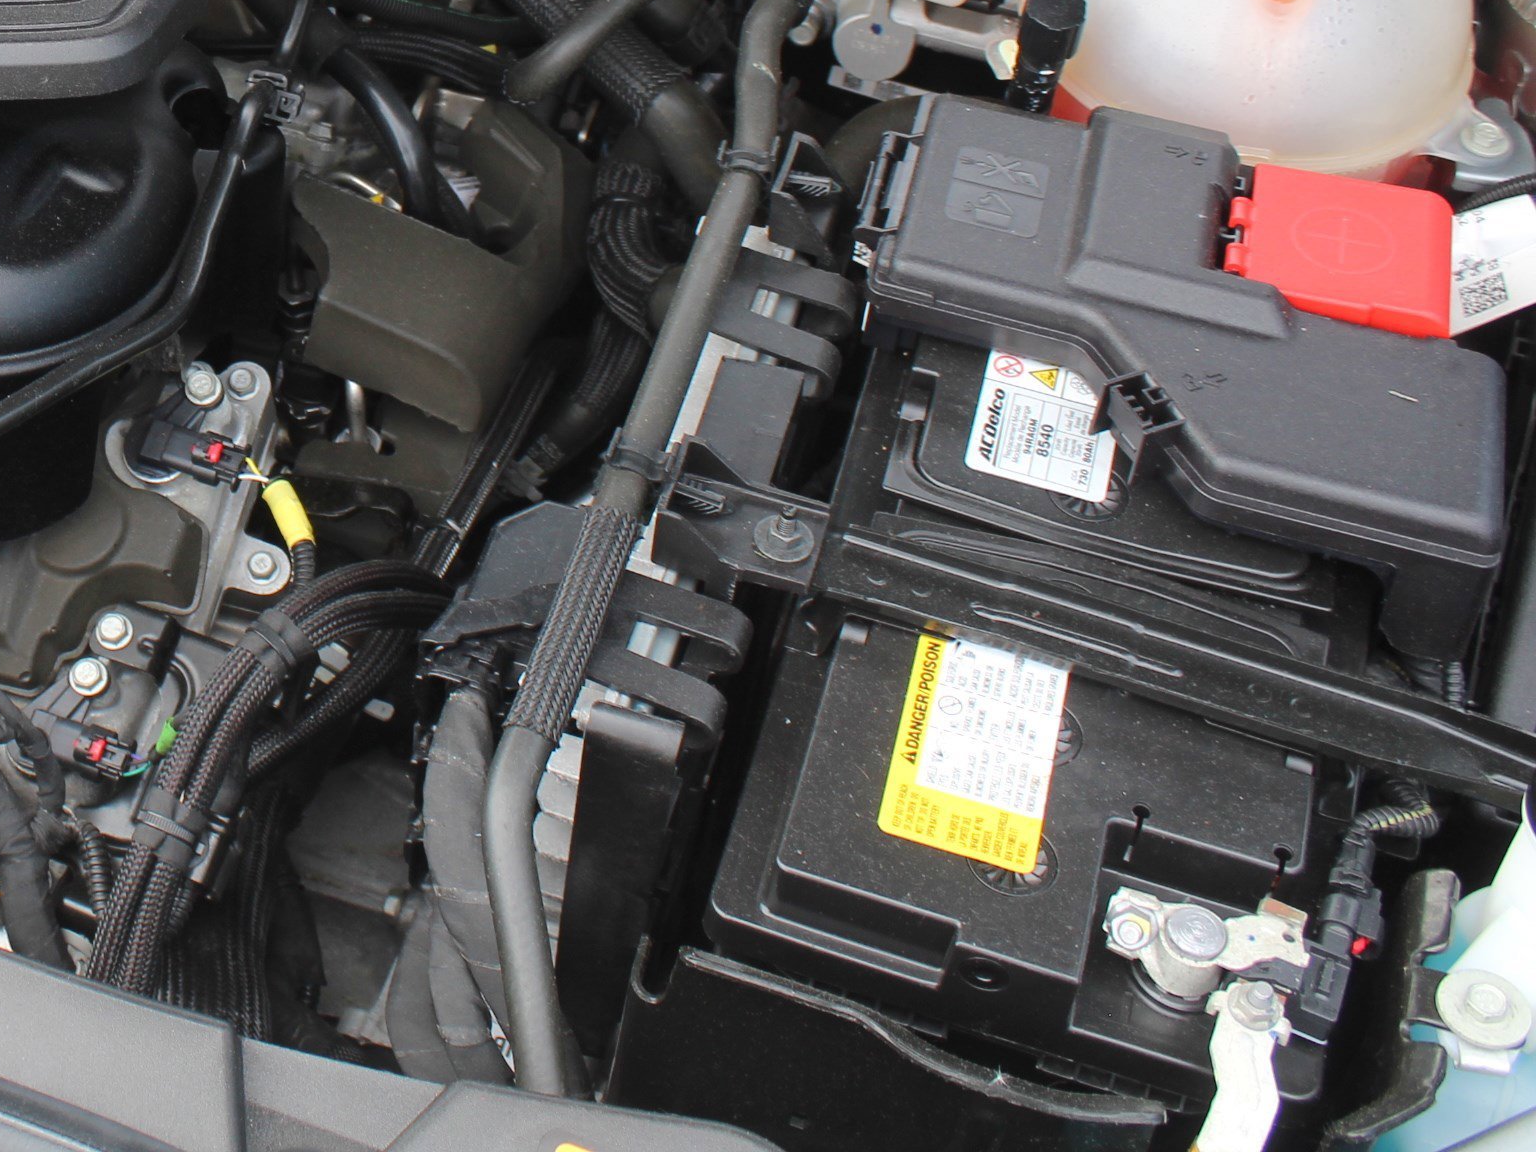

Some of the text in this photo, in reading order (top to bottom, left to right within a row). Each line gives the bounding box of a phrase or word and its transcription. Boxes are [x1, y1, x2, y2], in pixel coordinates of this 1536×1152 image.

[978, 388, 1005, 461] ACDelco
[1037, 423, 1055, 457] 8540
[1082, 440, 1094, 463] 80Ah
[1078, 468, 1088, 486] 730
[906, 641, 941, 749] DANGER/POISON
